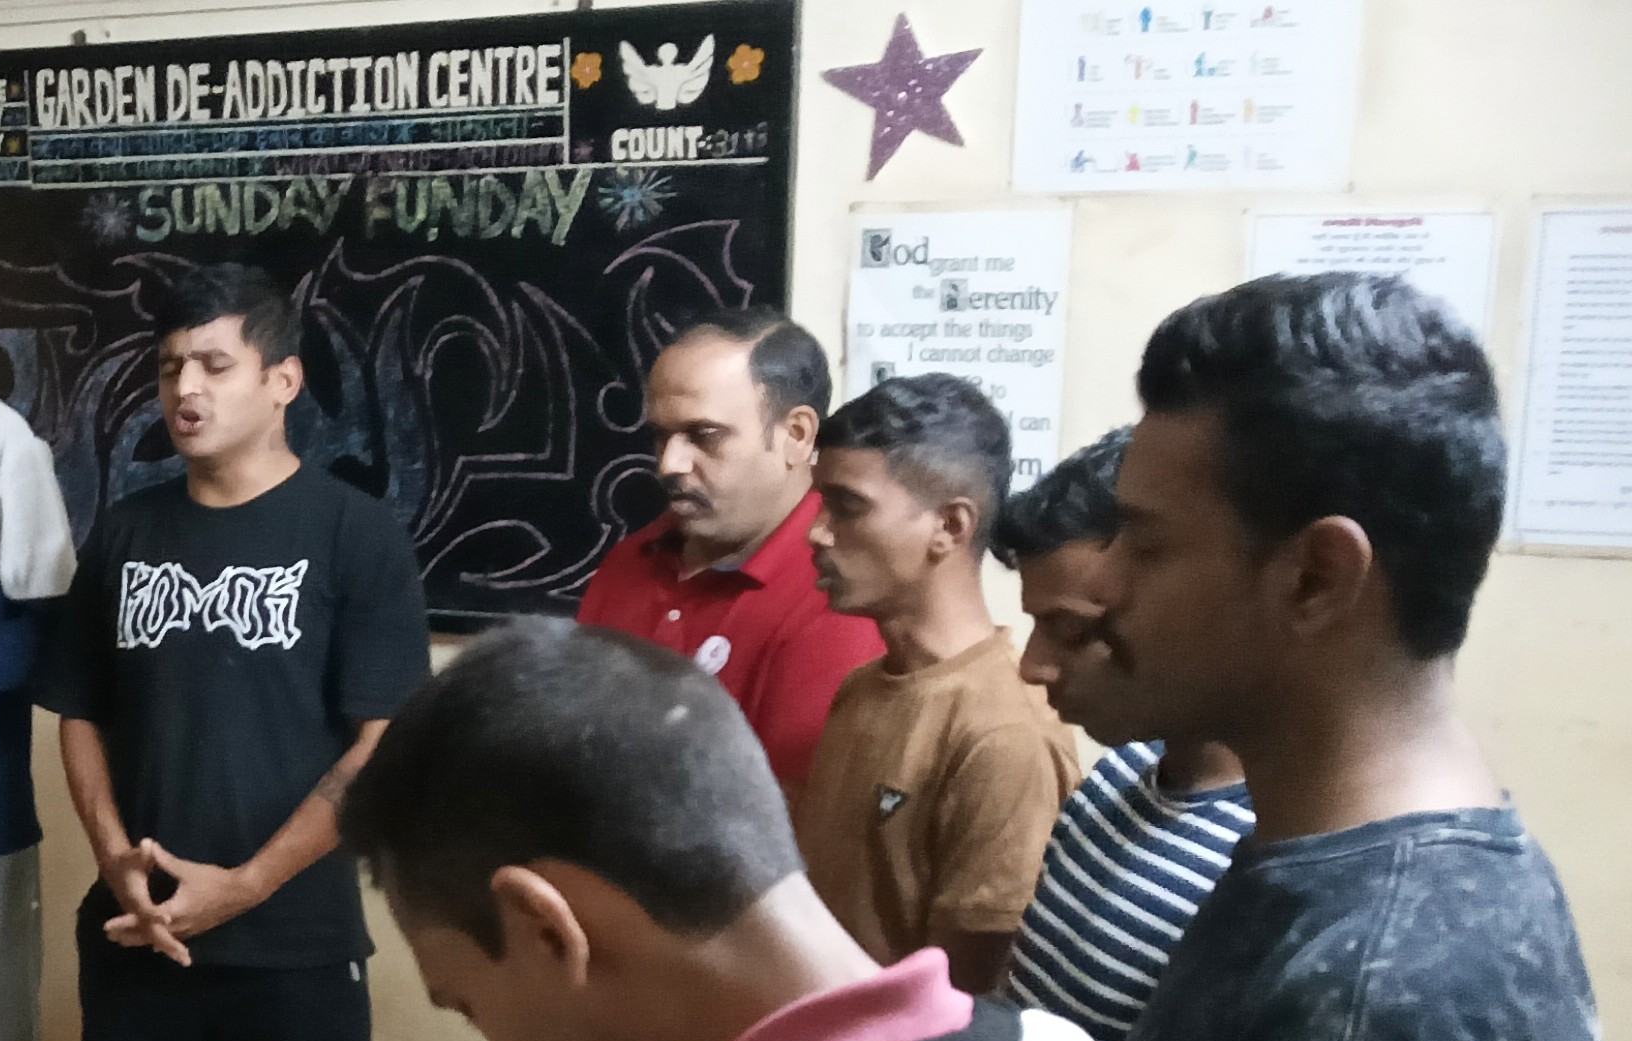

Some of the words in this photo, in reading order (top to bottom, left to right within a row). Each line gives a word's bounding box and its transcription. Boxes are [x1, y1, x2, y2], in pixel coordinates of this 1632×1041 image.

[36, 66, 156, 129] GARDEN
[167, 51, 420, 122] DE-ADDICTION
[428, 43, 561, 106] CENTRE
[136, 173, 354, 243] SUNDAY
[367, 168, 594, 247] FUNDAY
[928, 256, 980, 277] grant
[984, 256, 1016, 272] me
[856, 322, 876, 338] to
[880, 321, 939, 341] accept
[943, 317, 973, 338] the
[978, 320, 1033, 343] things
[919, 345, 982, 363] cannot
[986, 345, 1056, 368] change
[1019, 414, 1051, 432] can
